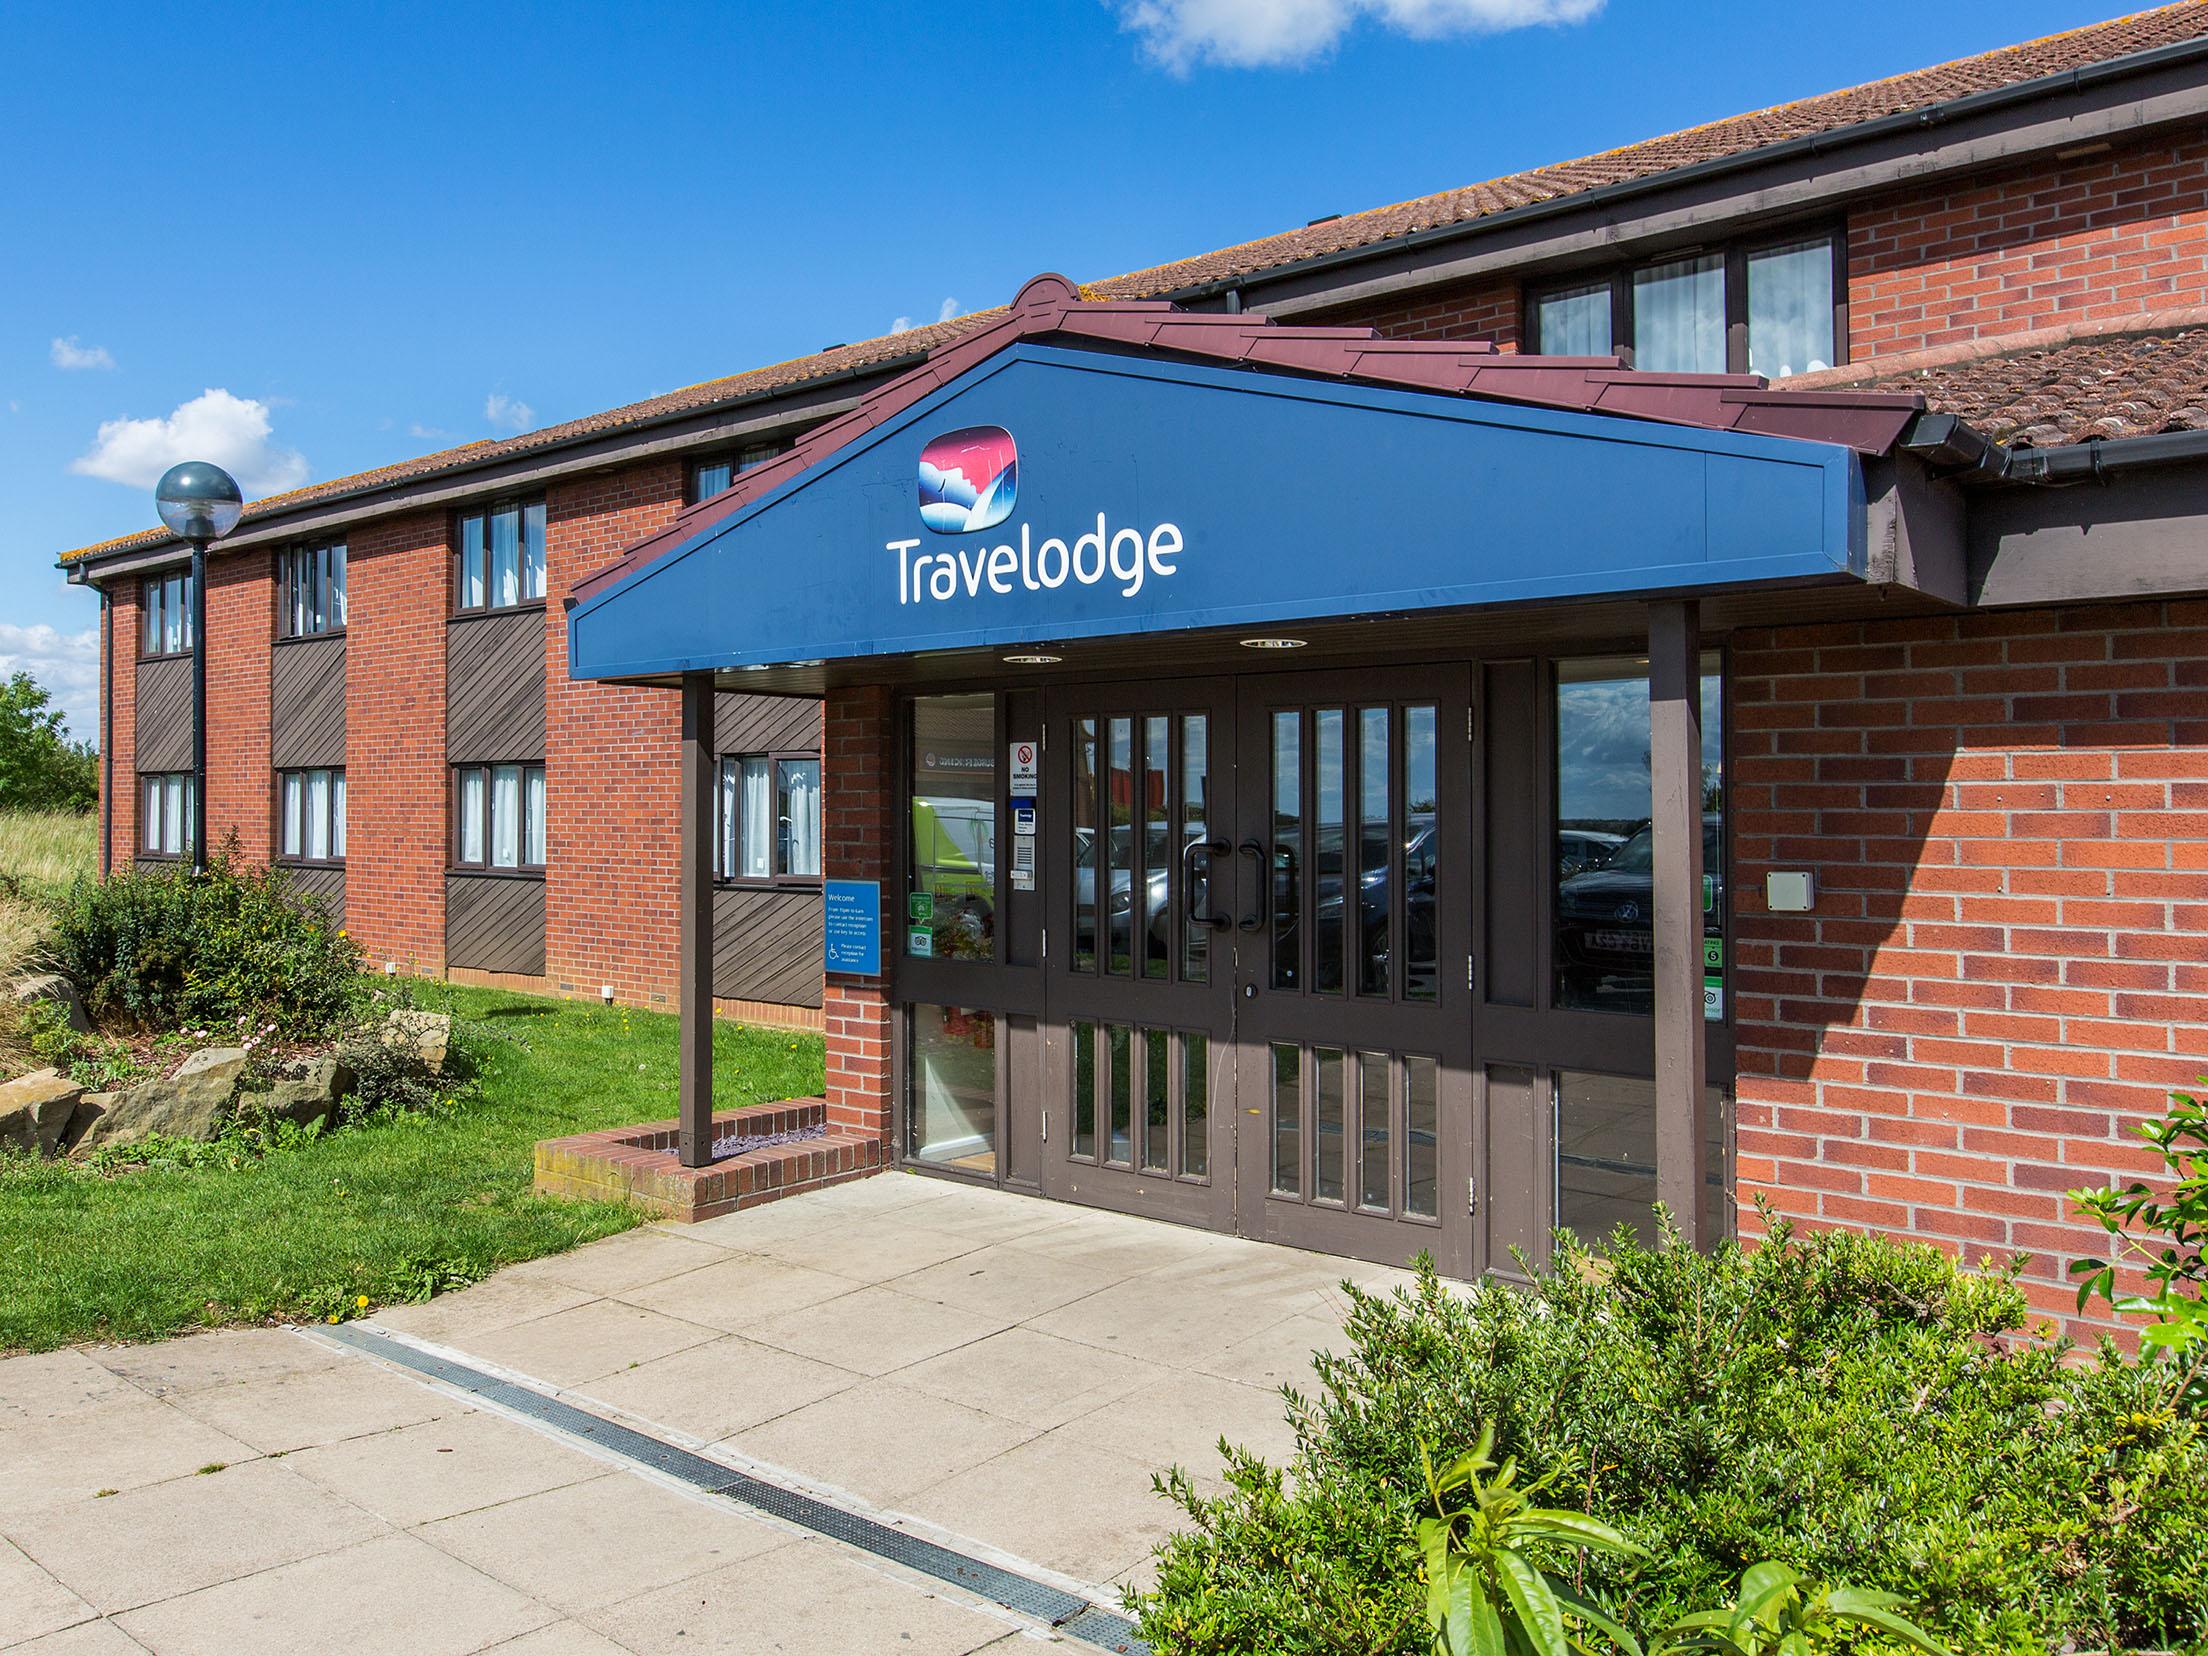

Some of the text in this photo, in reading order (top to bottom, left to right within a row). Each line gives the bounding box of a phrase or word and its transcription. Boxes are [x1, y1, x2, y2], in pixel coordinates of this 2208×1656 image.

[885, 511, 1184, 605] Travelodge
[828, 893, 855, 902] Welcome
[1710, 952, 1717, 960] 5
